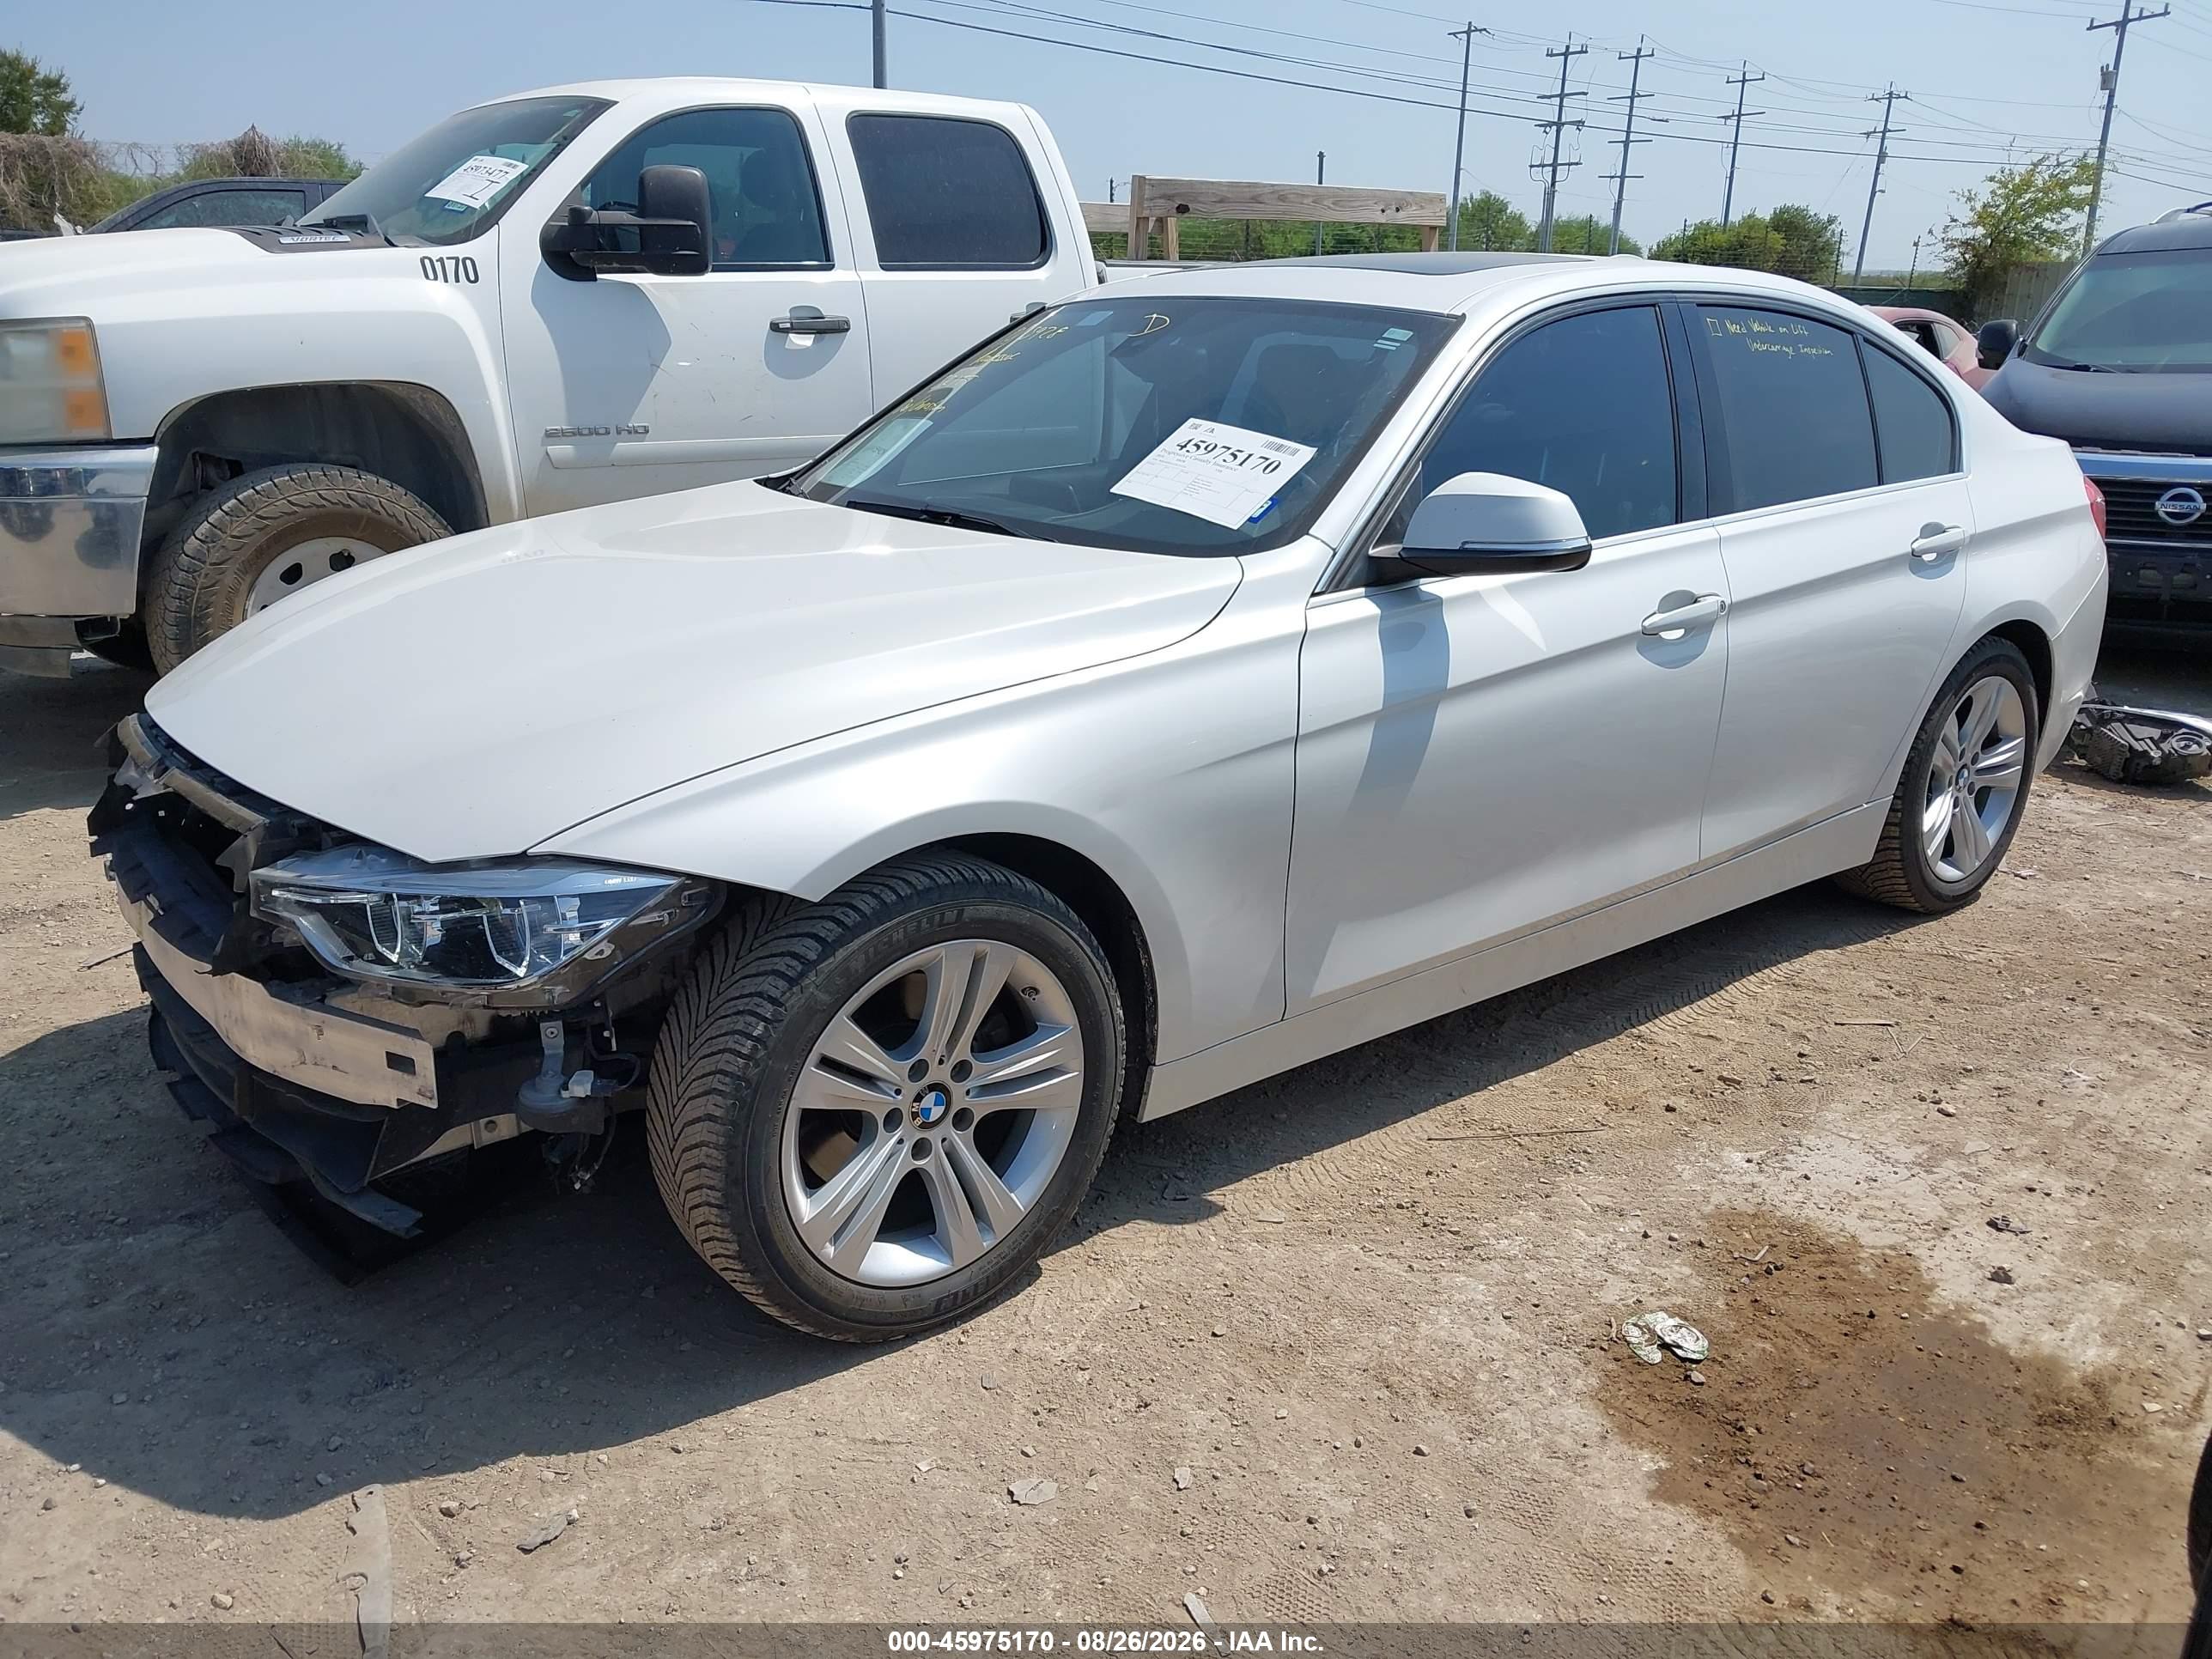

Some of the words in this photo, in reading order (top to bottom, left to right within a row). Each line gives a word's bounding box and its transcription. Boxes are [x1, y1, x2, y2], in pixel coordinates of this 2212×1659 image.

[419, 255, 480, 284] 0170
[1126, 313, 1170, 337] D
[544, 425, 611, 439] 2500
[616, 422, 650, 435] HD
[1176, 436, 1282, 476] 45975170
[2160, 502, 2201, 511] NISSAN
